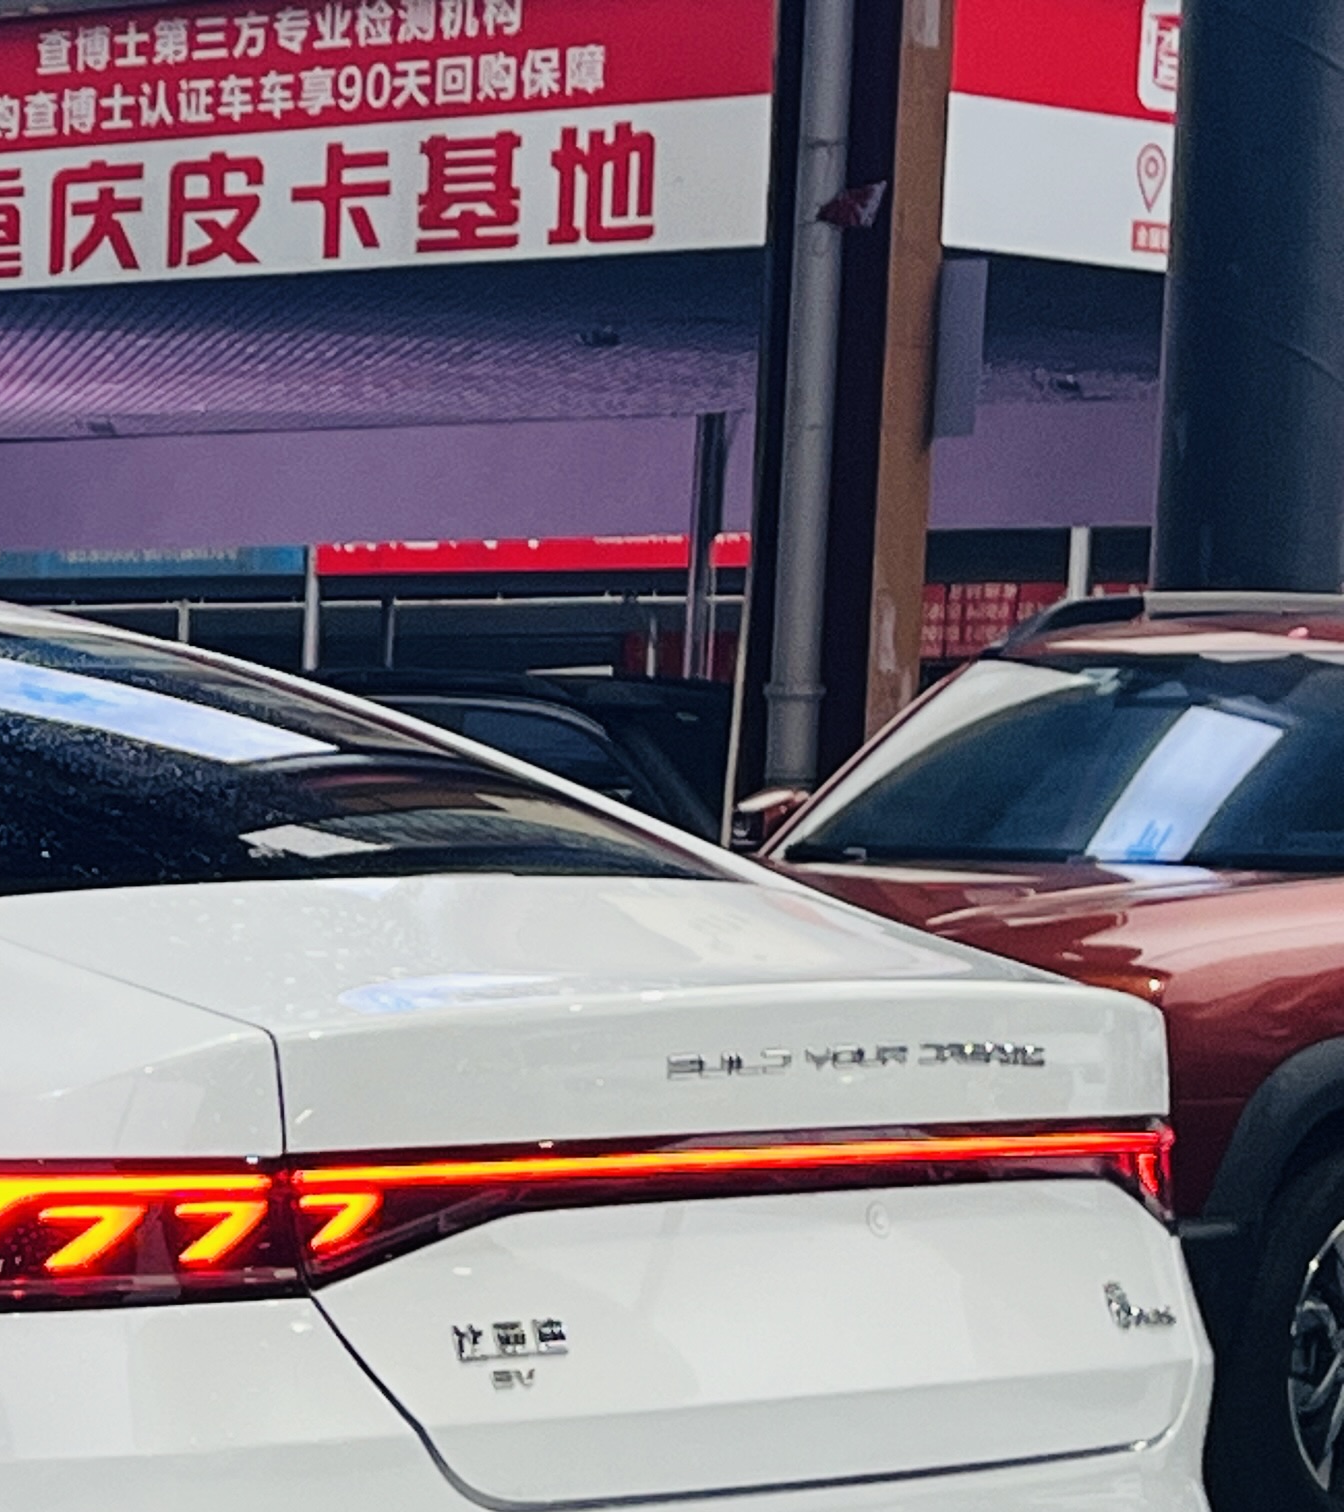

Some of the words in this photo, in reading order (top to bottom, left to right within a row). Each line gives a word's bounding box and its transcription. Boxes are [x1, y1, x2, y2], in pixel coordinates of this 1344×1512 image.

[36, 0, 522, 75] 查博士第三方专业检测机构
